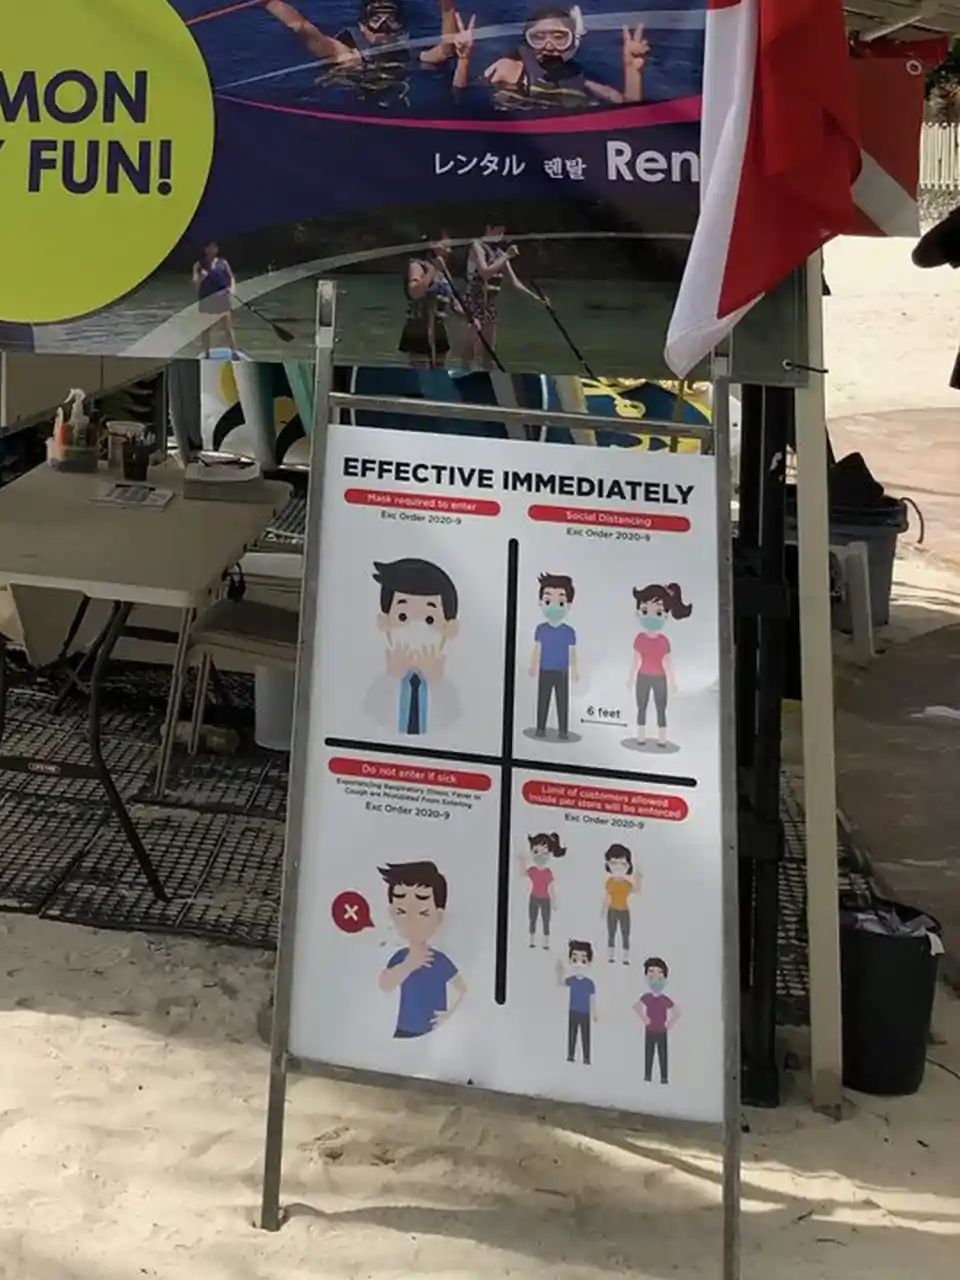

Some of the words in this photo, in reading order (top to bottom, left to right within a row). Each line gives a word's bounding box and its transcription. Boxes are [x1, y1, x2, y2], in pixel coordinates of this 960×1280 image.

[27, 140, 173, 196] FUN!
[434, 152, 526, 177] レンタル
[606, 140, 701, 183] Ren
[343, 457, 495, 489] EFFECTIVE
[502, 470, 695, 505] IMMEDIATELY
[366, 492, 391, 504] Mask
[450, 500, 477, 511] enter
[399, 511, 425, 522] Order
[428, 514, 462, 526] 2020-9
[566, 510, 596, 521] Social
[585, 528, 613, 539] Order
[586, 704, 595, 717] 6
[598, 706, 620, 719] feet
[361, 763, 376, 775] Do
[378, 766, 396, 776] not
[398, 768, 425, 780] enter
[437, 772, 458, 784] sick
[365, 801, 382, 812] Exc
[384, 803, 413, 815] Order
[415, 807, 451, 820] 2020-9
[582, 814, 609, 825] Order
[611, 818, 645, 830] 2020-9
